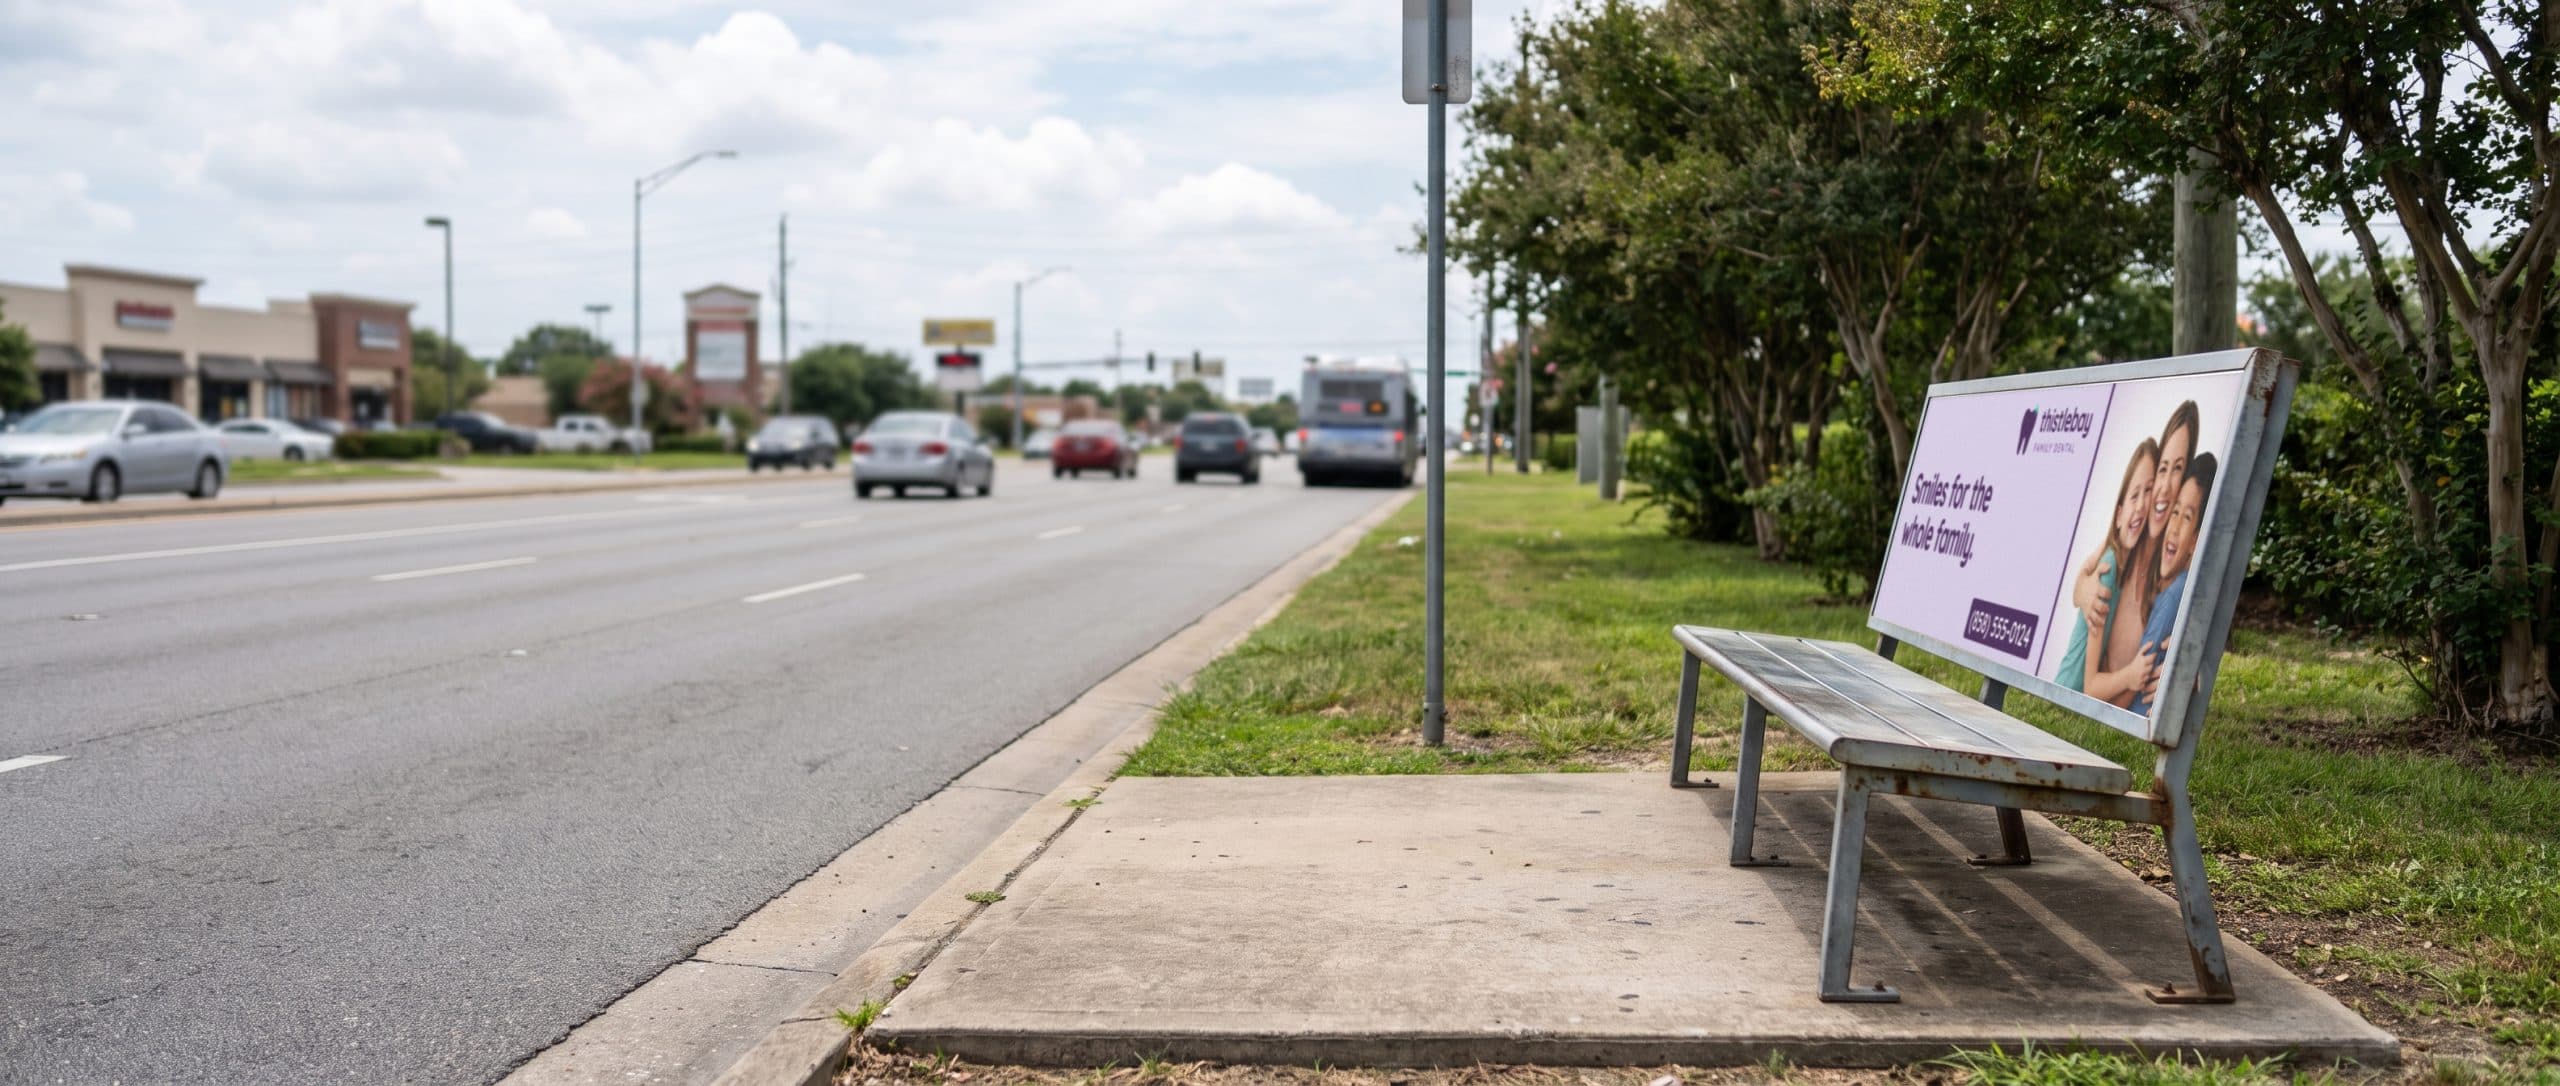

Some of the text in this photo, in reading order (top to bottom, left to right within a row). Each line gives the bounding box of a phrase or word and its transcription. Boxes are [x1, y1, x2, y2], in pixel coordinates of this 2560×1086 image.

[2039, 407, 2094, 439] thistlebay
[1911, 472, 1993, 512] Smiles for the
[1901, 514, 1975, 568] whole family.
[1968, 609, 2032, 648] (858) 555-0124
